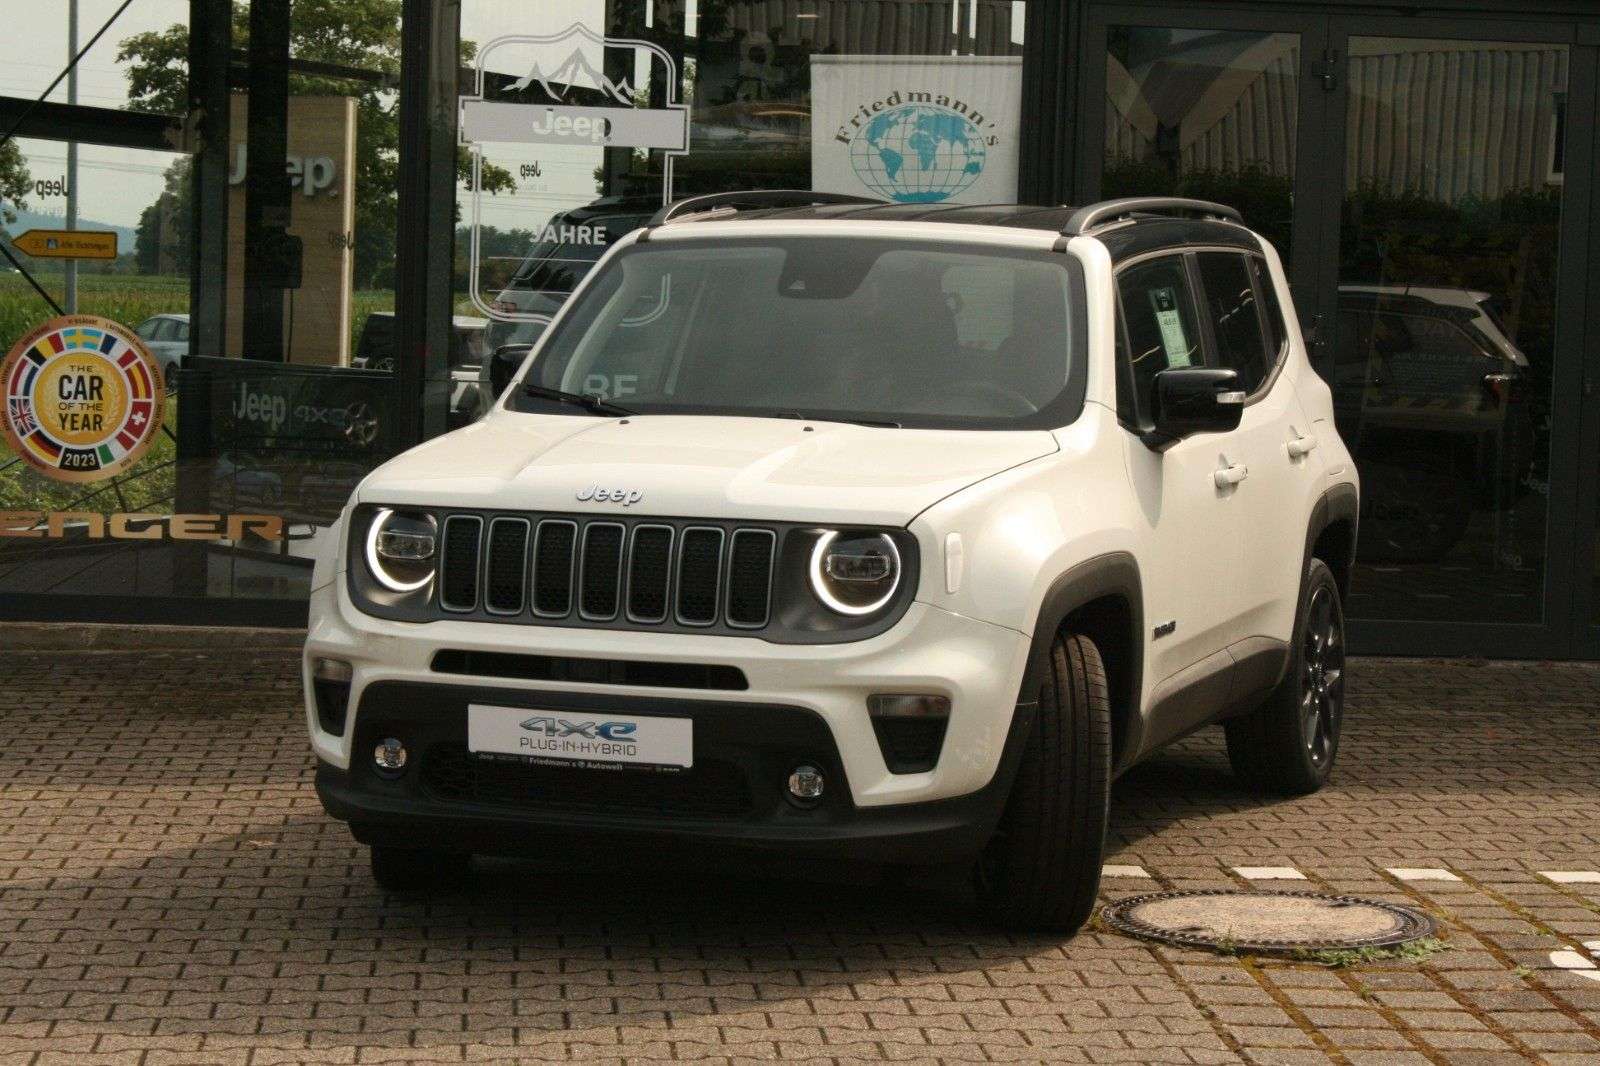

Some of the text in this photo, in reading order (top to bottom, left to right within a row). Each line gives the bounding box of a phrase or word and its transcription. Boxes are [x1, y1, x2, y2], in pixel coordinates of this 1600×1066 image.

[532, 108, 613, 143] Jeep
[834, 90, 1000, 146] Friedmann's
[228, 144, 336, 197] Jep
[530, 224, 607, 246] JAHRE
[70, 365, 93, 373] THE
[58, 374, 104, 401] CAR
[58, 401, 103, 412] OF THE
[233, 382, 288, 431] Jeep
[58, 413, 103, 432] YEAR
[64, 452, 97, 467] 2023
[576, 483, 644, 507] Jeep
